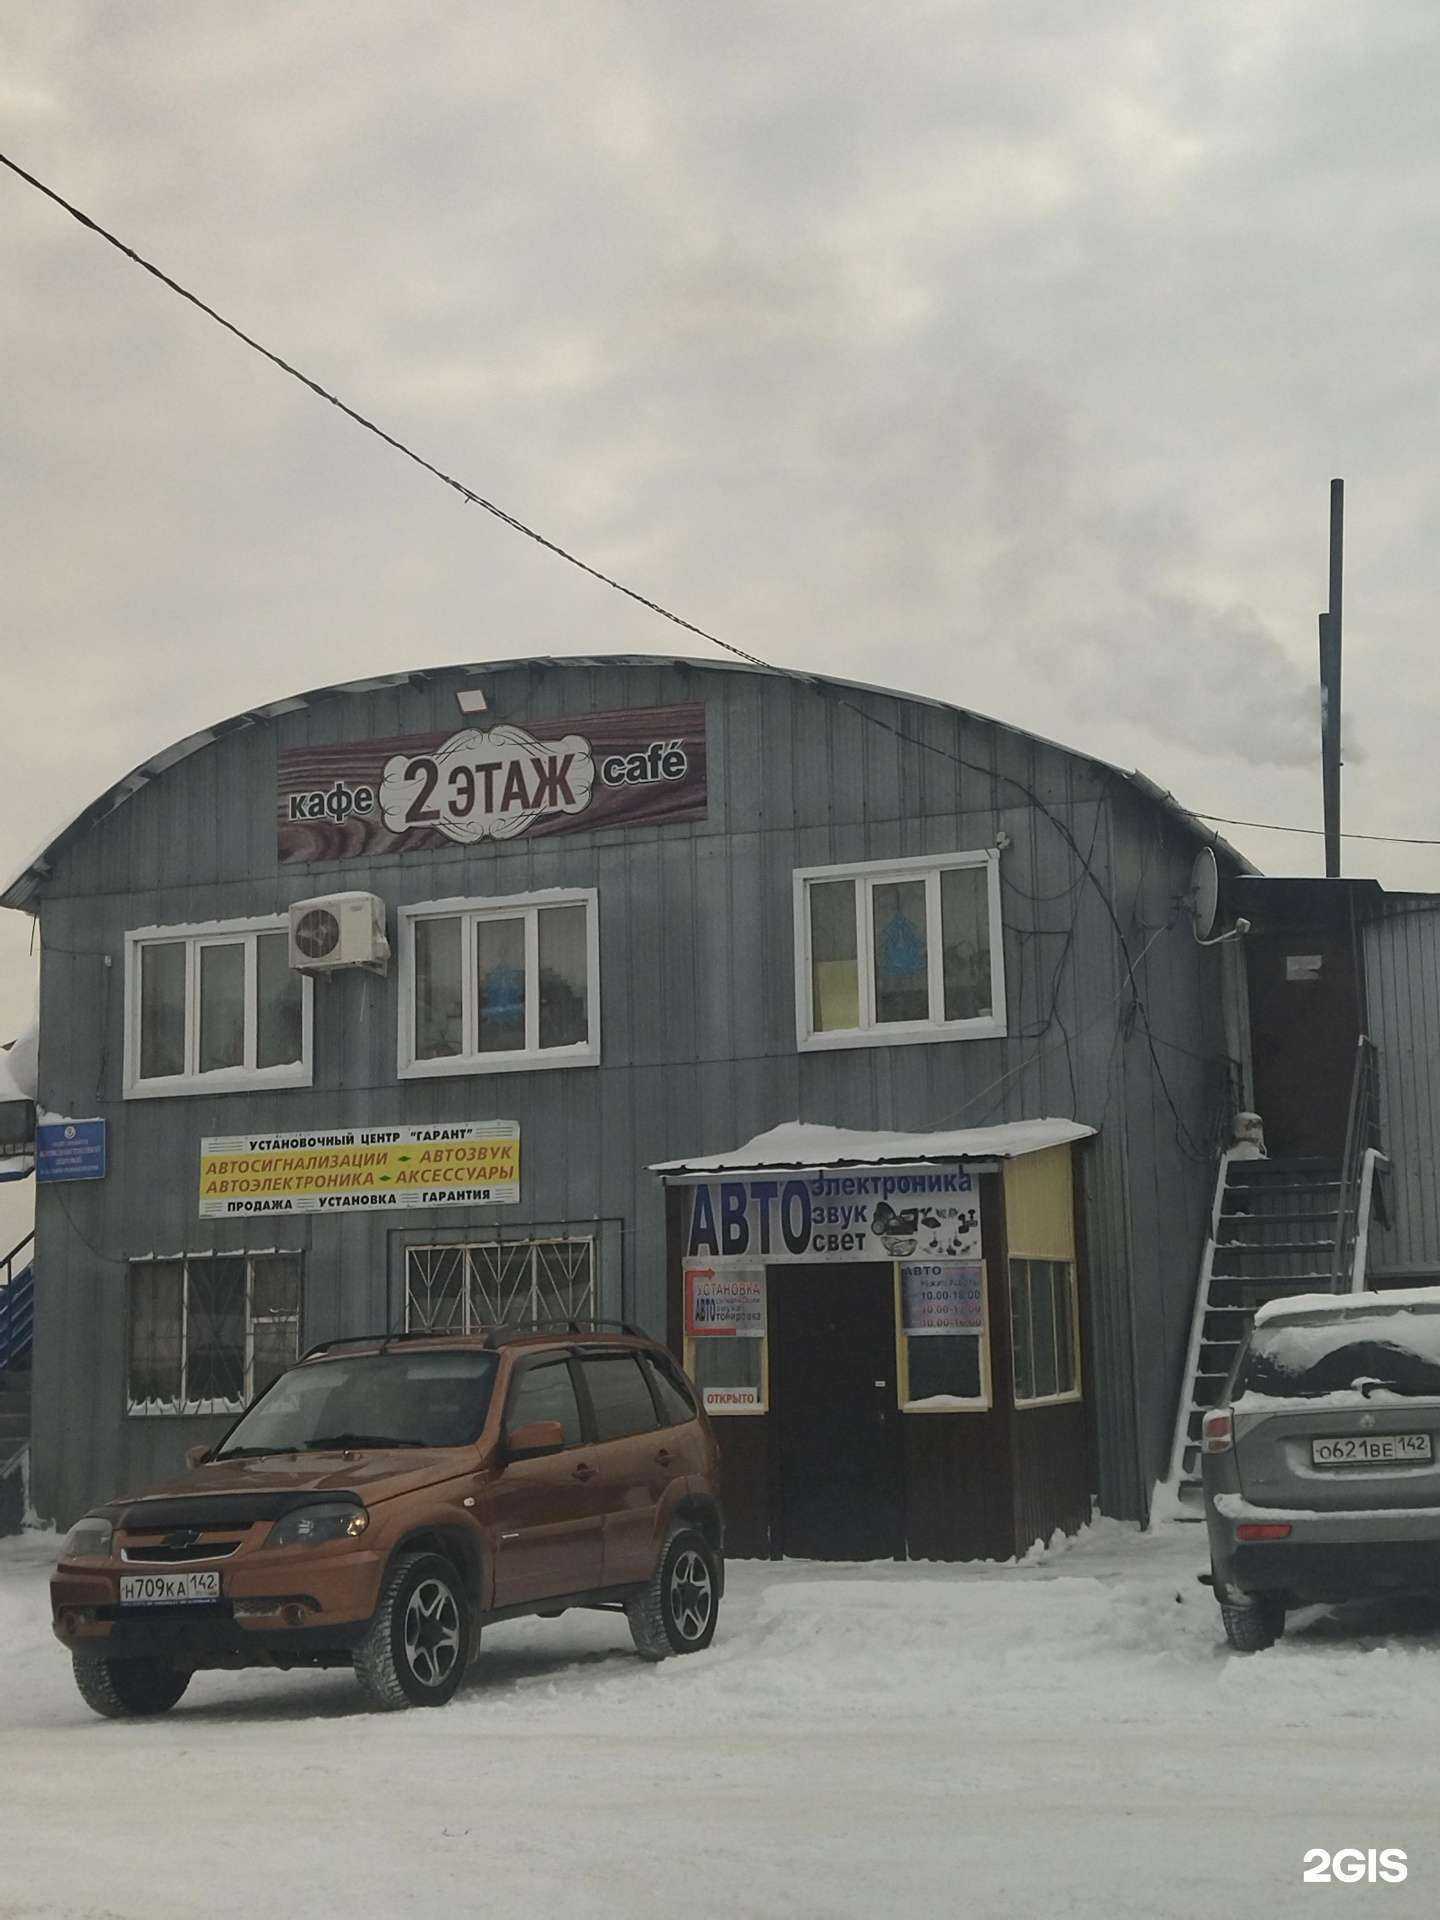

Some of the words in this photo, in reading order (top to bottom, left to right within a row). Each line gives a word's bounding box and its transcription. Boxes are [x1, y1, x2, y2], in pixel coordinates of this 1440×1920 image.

[289, 782, 373, 823] кафе
[404, 759, 440, 823] 2
[447, 753, 577, 817] ЭТАЖ
[601, 740, 687, 788] café
[249, 1132, 355, 1151] УСТАНОВОЧНЫЙ
[360, 1133, 400, 1146] ЦЕНТР
[205, 1152, 388, 1175] АВТОСИГНАЛИЗАЦИИ
[420, 1146, 513, 1164] АВТОЗВУК
[205, 1172, 375, 1194] АВТОЭЛЕКТРОНИКА
[394, 1166, 514, 1185] АКСЕССУАРЫ
[811, 1173, 972, 1200] электроника
[227, 1200, 293, 1212] ПРОДАЖА
[318, 1194, 397, 1208] УСТАНОВКА
[422, 1190, 490, 1203] ГАРАНТИЯ
[688, 1180, 812, 1256] АВТО
[811, 1205, 867, 1229] звук
[812, 1233, 866, 1251] свет
[903, 1266, 942, 1276] АВТО
[707, 1393, 754, 1404] ОТКРЫТО
[1398, 1436, 1425, 1451] 142
[125, 1578, 186, 1599] Н709КА
[190, 1574, 215, 1590] 142
